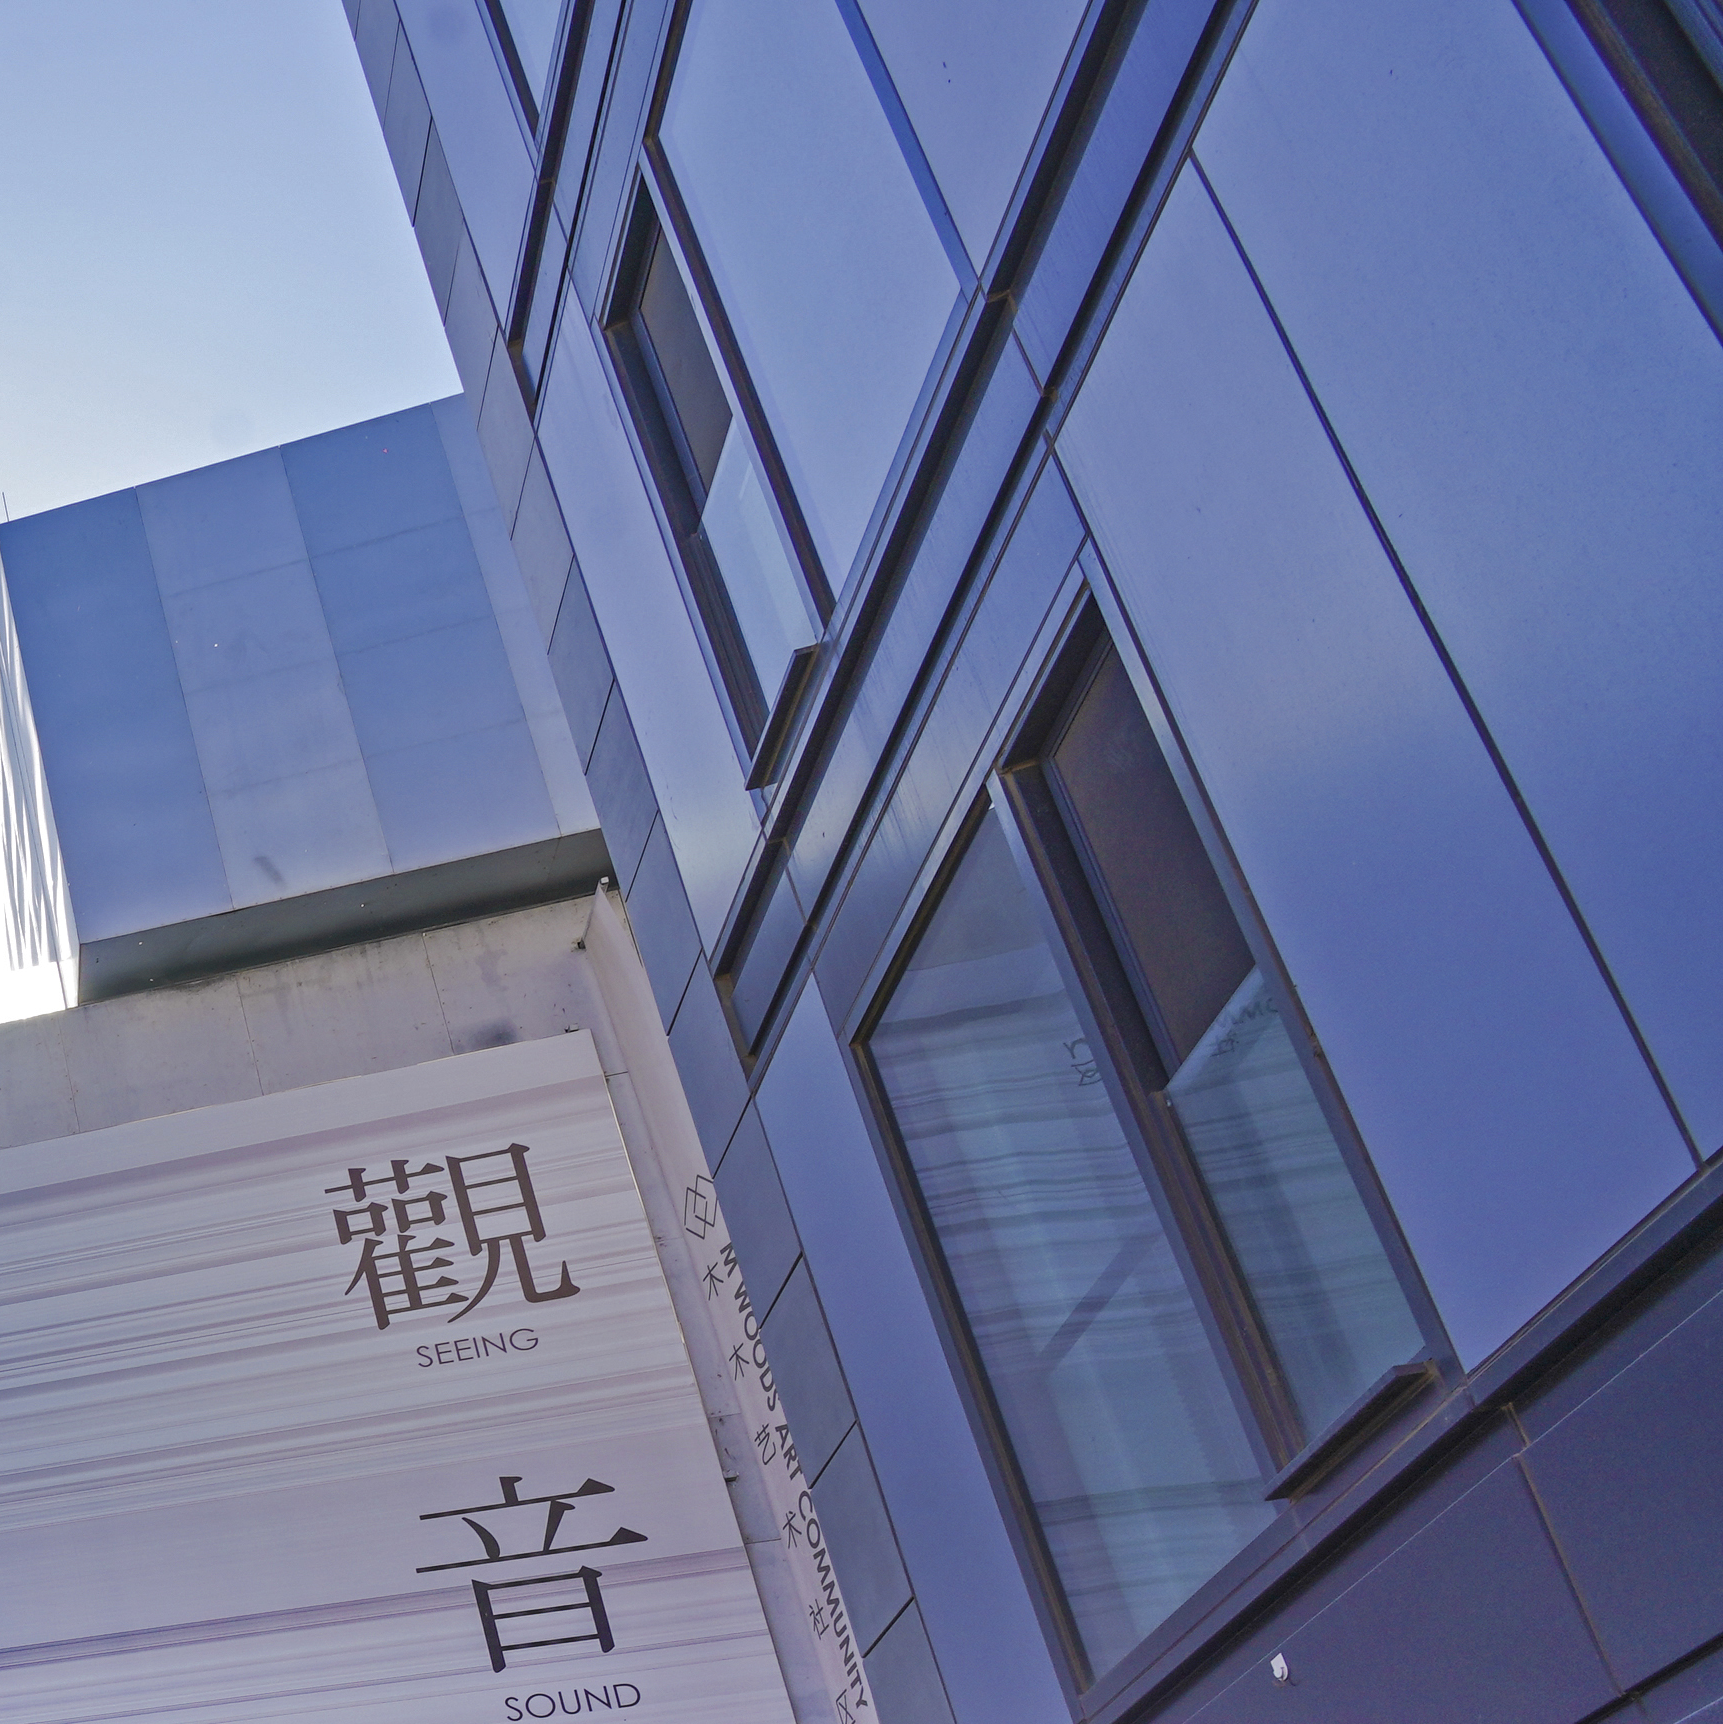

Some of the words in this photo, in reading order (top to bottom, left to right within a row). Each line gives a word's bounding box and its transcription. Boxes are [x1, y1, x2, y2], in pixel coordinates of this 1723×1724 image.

[324, 1142, 580, 1330] 觀
[416, 1328, 539, 1368] SEEING
[415, 1476, 648, 1673] 音
[733, 1281, 780, 1412] WOODS
[775, 1424, 804, 1481] ART
[798, 1490, 868, 1709] COMMUNITY
[504, 1682, 641, 1722] SOUND
